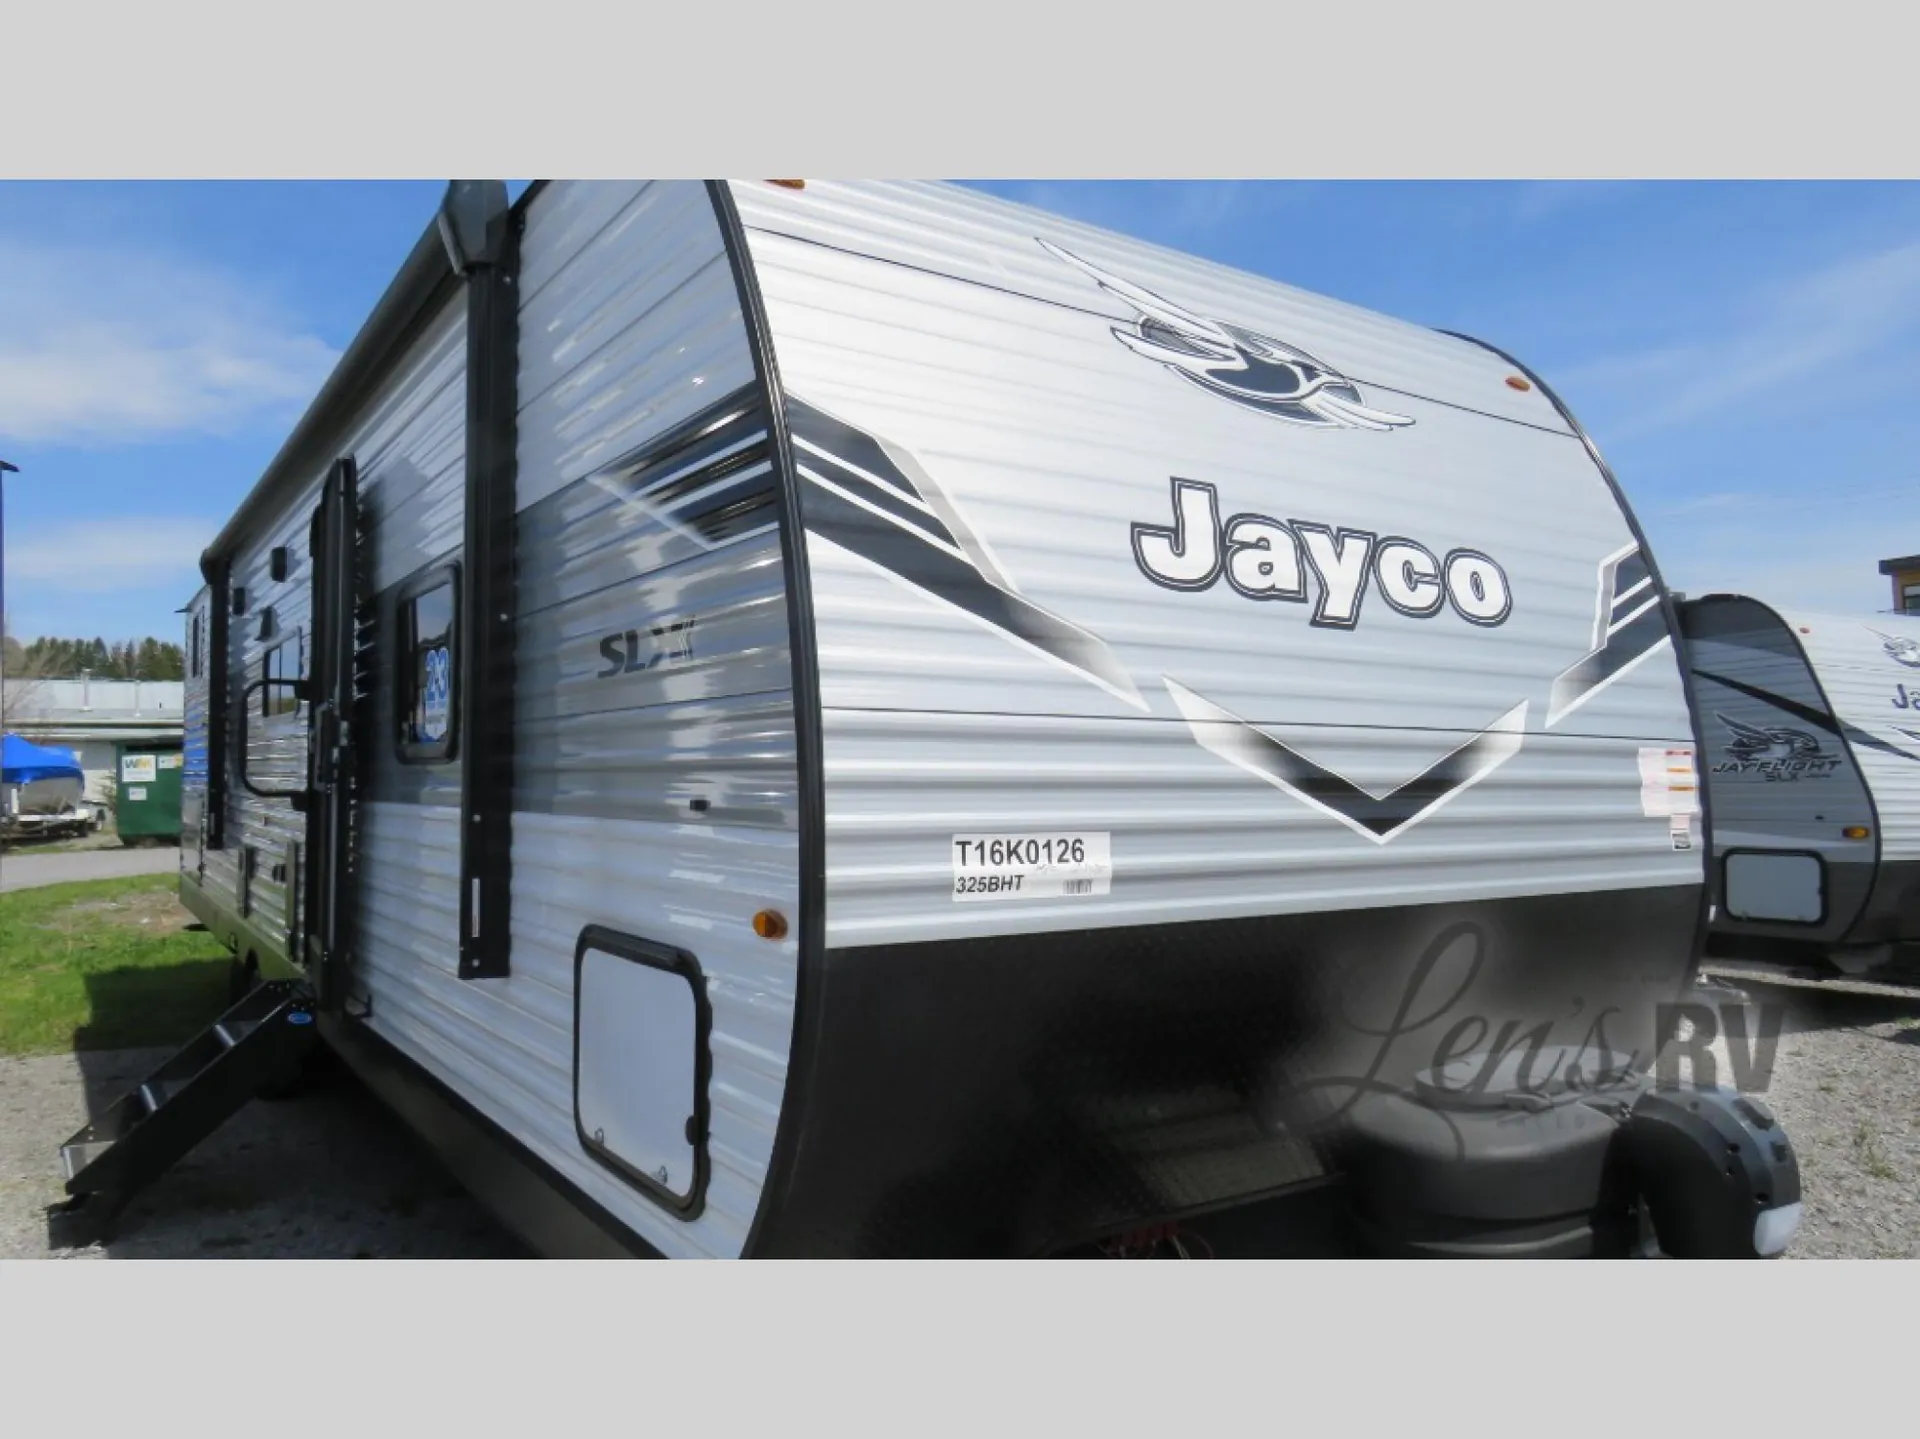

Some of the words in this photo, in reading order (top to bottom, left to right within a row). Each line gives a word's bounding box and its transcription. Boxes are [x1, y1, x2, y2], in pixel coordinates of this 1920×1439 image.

[1130, 476, 1513, 630] Jayco
[955, 839, 1085, 867] T16K0126
[955, 874, 1025, 894] 325BHT
